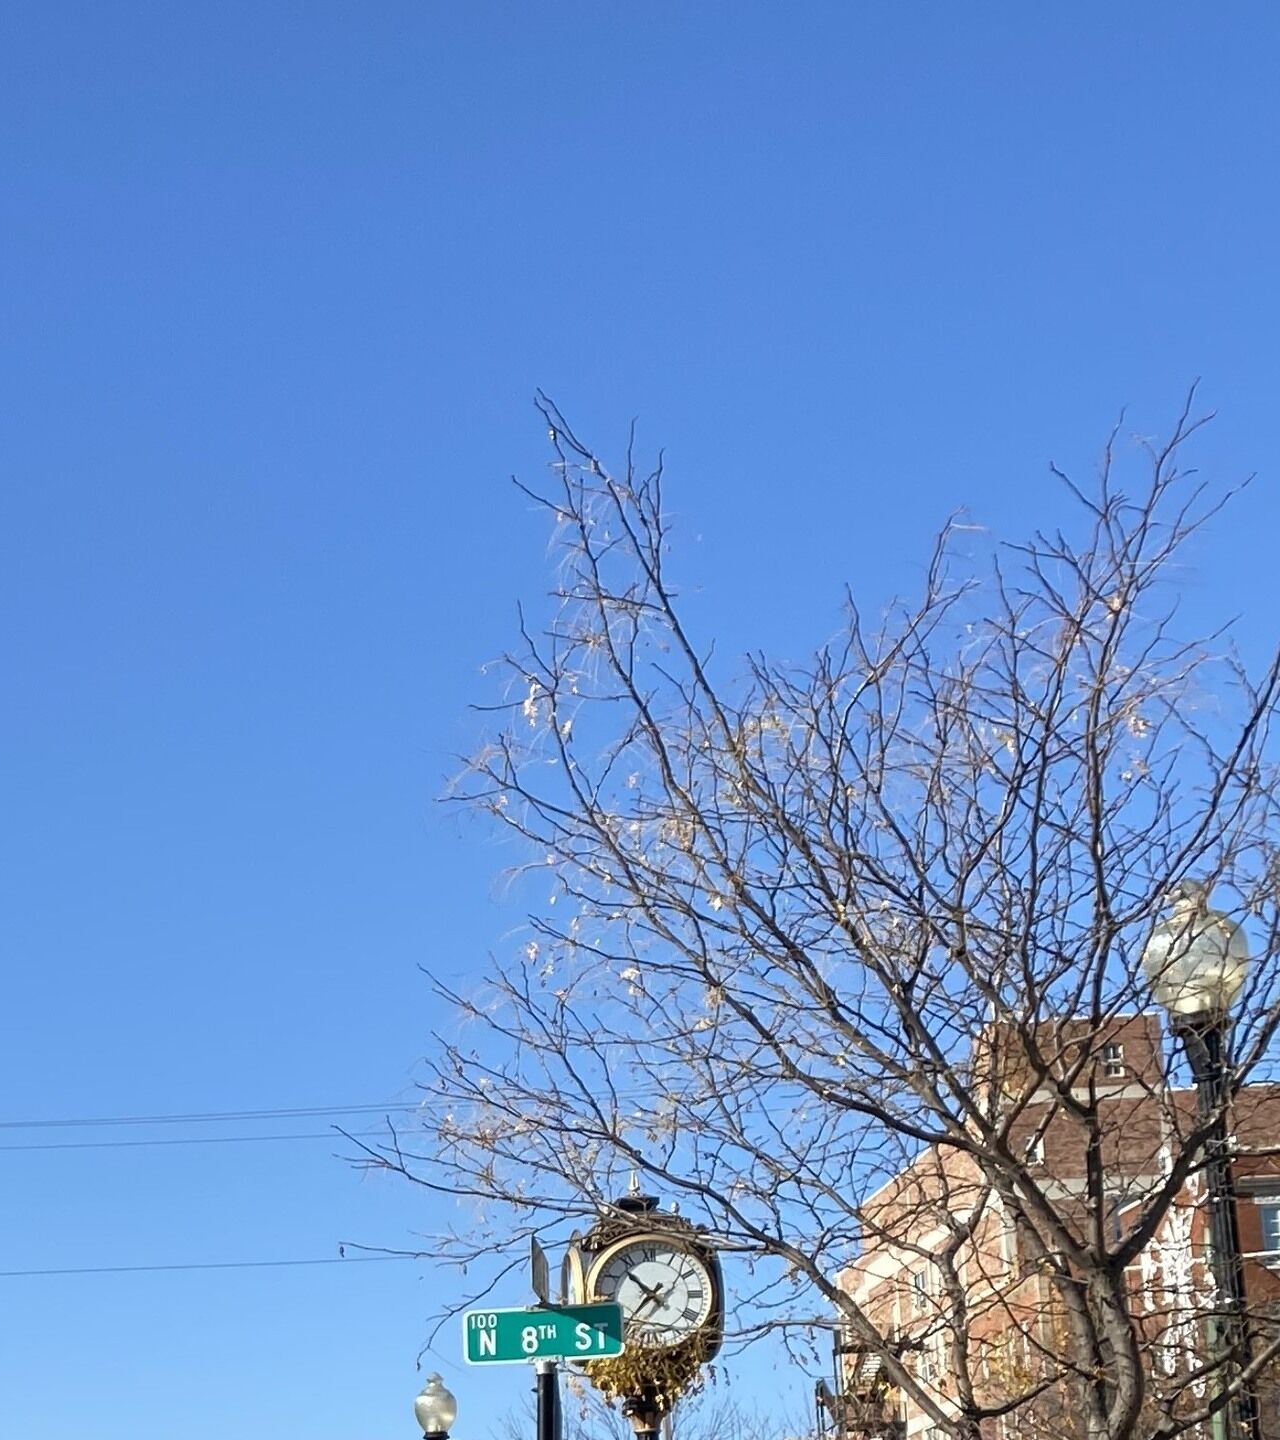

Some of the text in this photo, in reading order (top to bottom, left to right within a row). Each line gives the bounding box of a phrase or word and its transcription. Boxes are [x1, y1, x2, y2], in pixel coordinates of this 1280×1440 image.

[470, 1313, 498, 1330] 100
[479, 1322, 609, 1357] N 8TH ST
